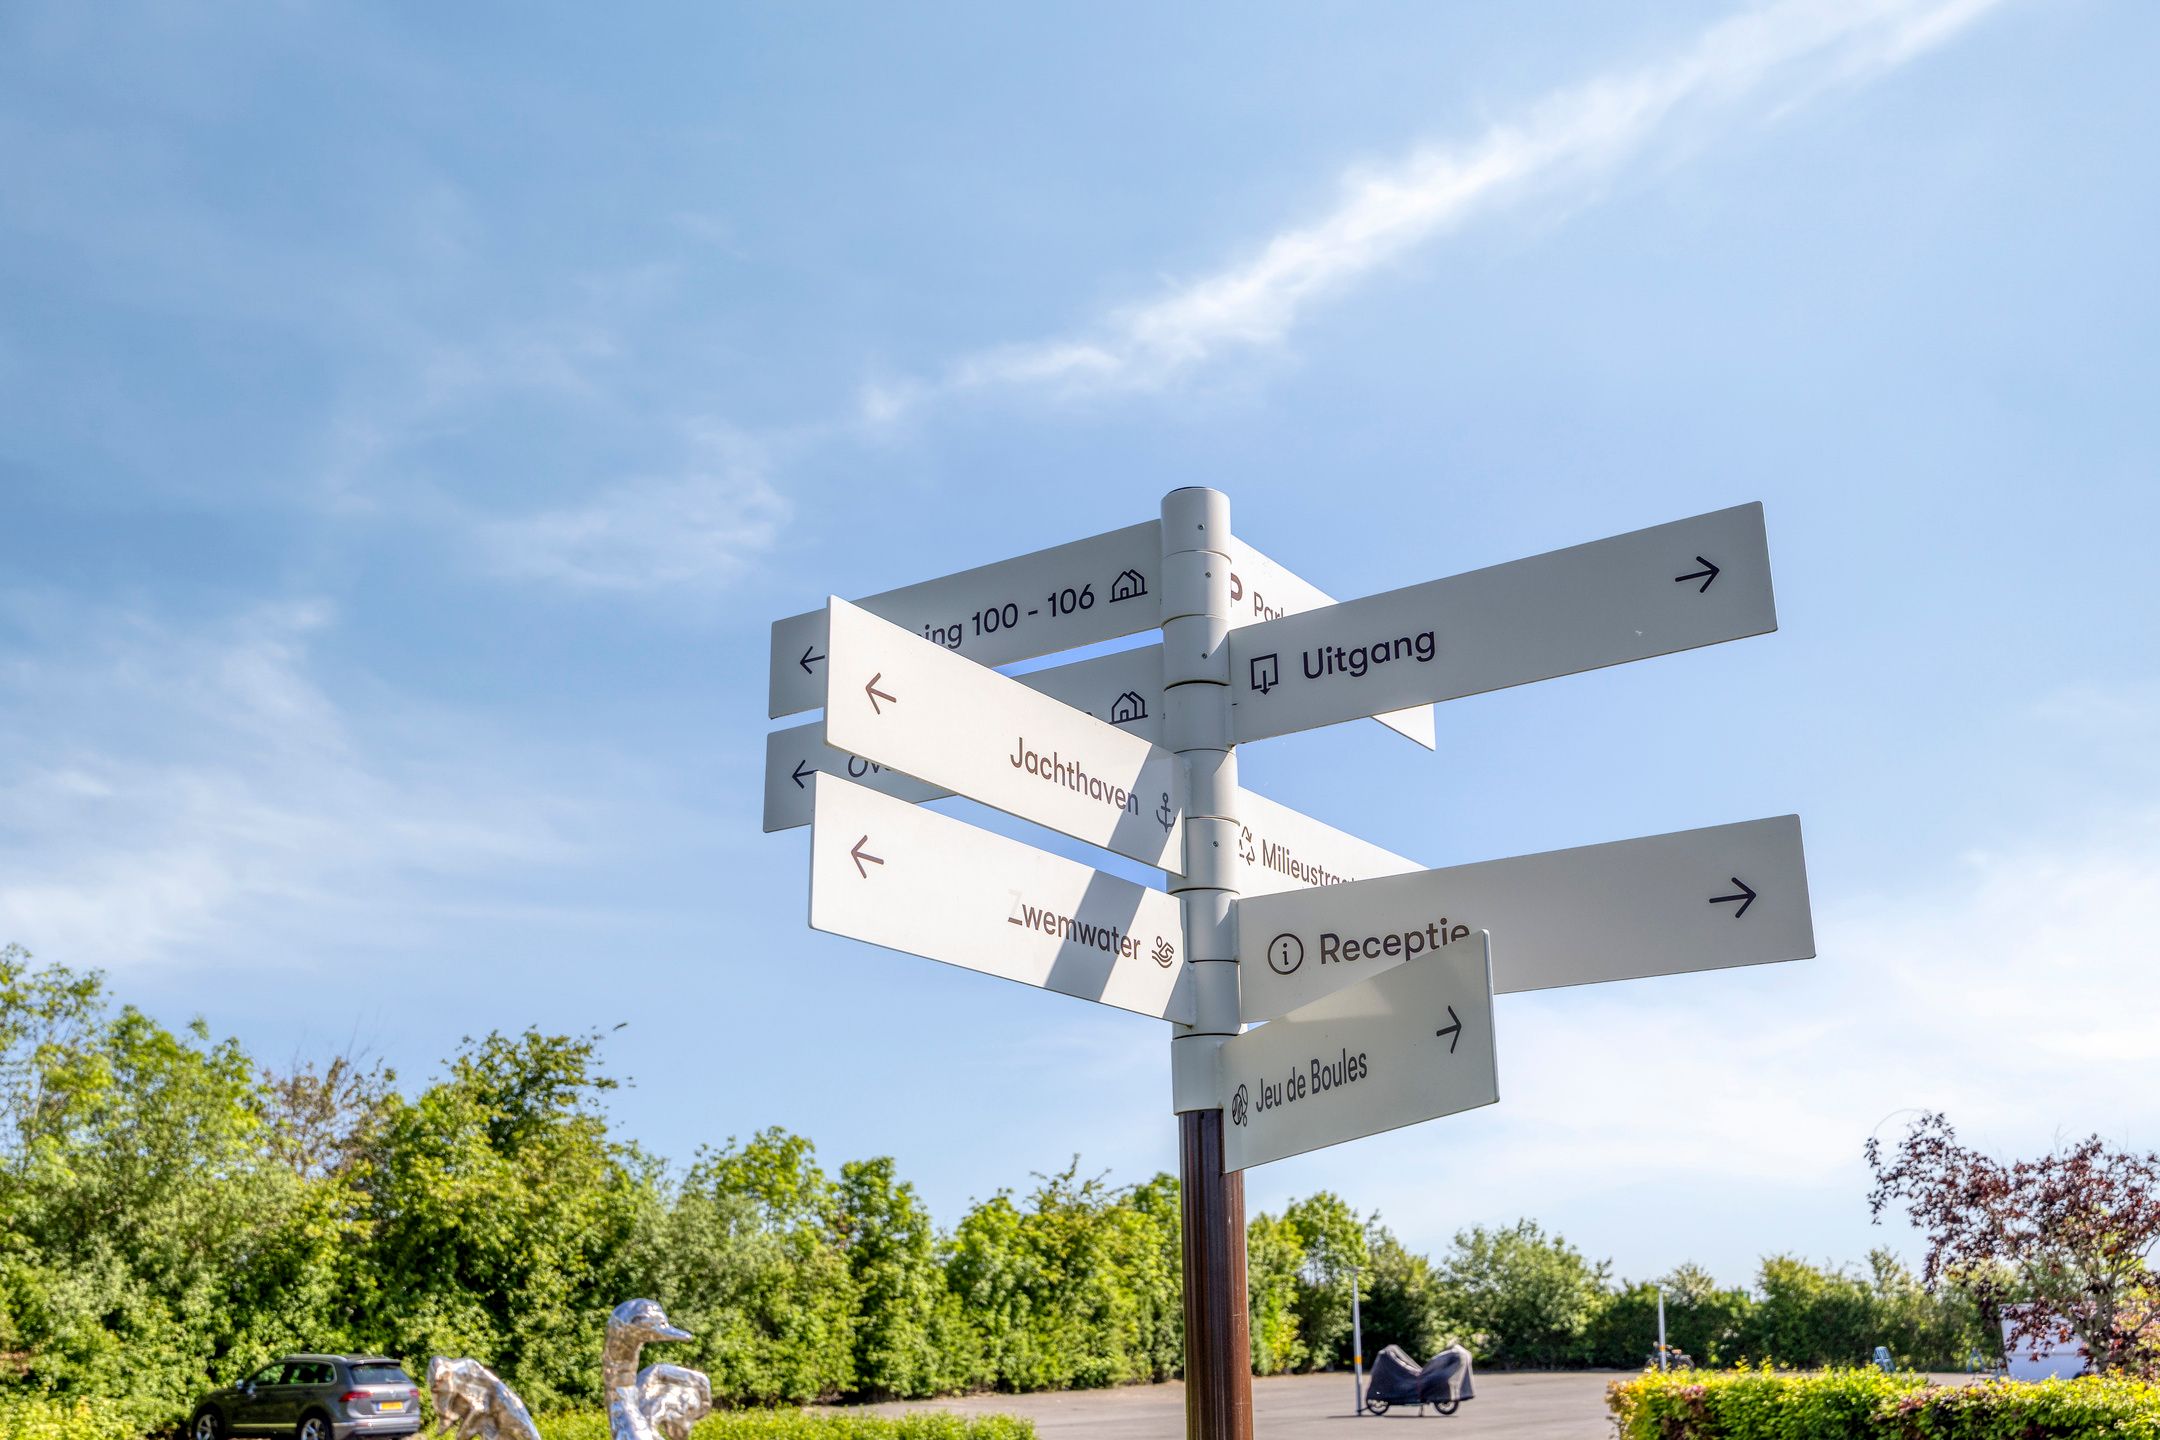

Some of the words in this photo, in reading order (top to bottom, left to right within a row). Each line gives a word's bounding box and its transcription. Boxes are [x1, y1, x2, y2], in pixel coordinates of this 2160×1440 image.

[916, 623, 963, 650] ing
[972, 603, 1019, 636] 100
[1048, 583, 1095, 618] 106
[1303, 631, 1435, 678] Uitgang
[1010, 737, 1139, 816] Jachthaven
[1256, 1078, 1282, 1112] Jeu
[1287, 1066, 1306, 1102] de
[1311, 1048, 1367, 1094] Boules
